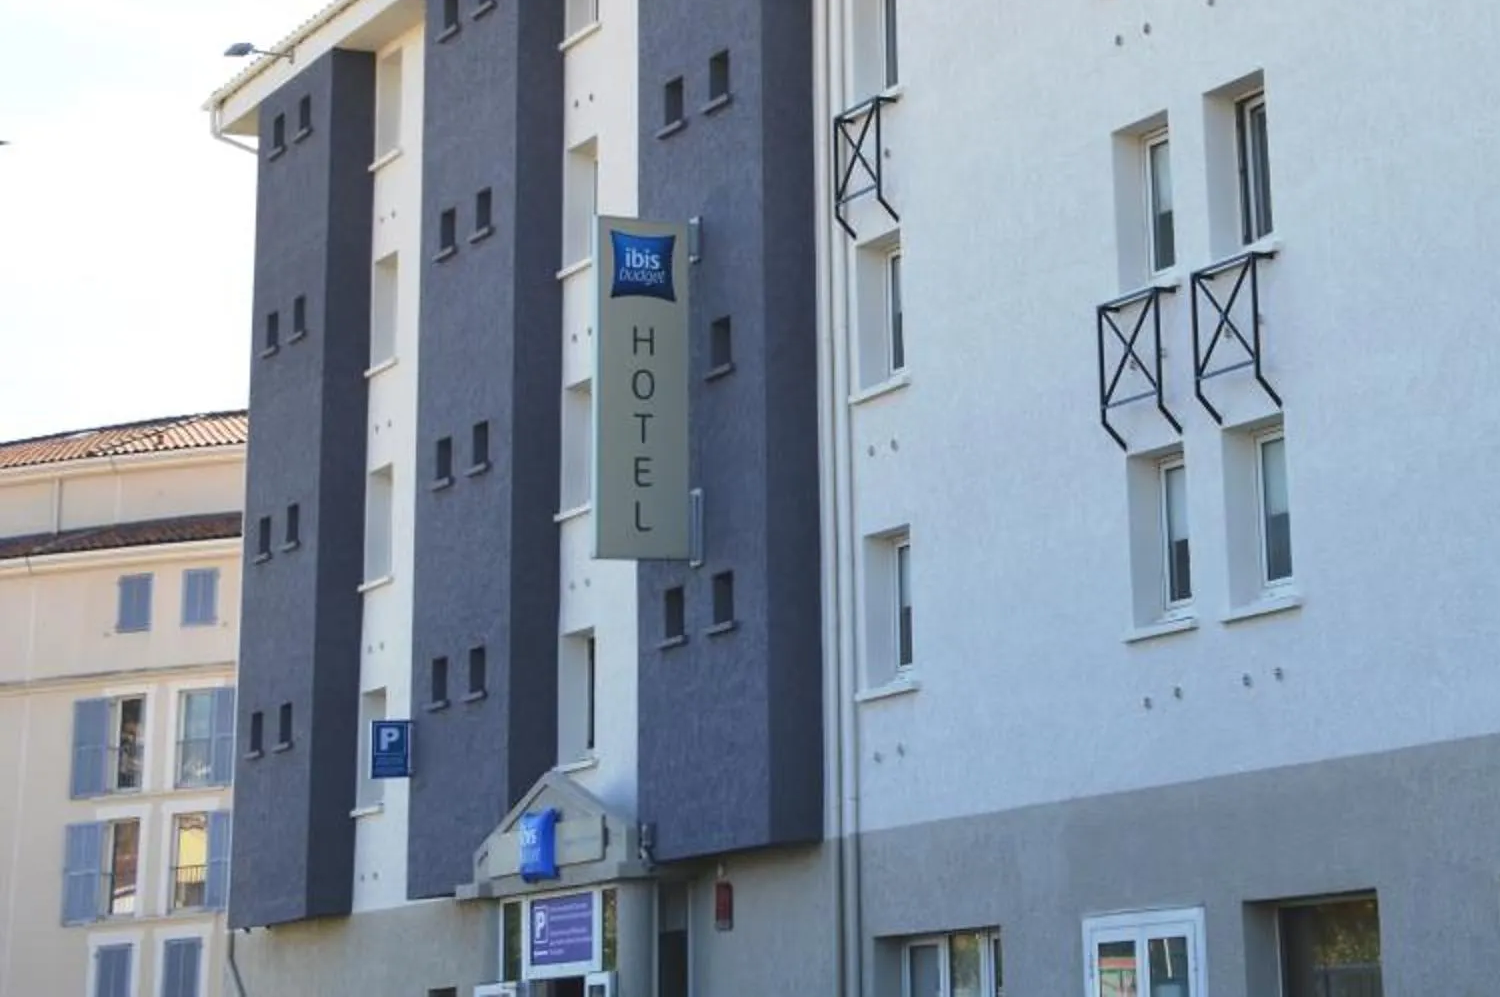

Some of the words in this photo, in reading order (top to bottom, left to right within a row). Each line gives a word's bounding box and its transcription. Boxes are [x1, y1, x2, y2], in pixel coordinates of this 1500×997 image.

[625, 246, 660, 270] ibis
[631, 325, 656, 531] HOTEL
[380, 727, 400, 751] P
[535, 911, 546, 939] P
